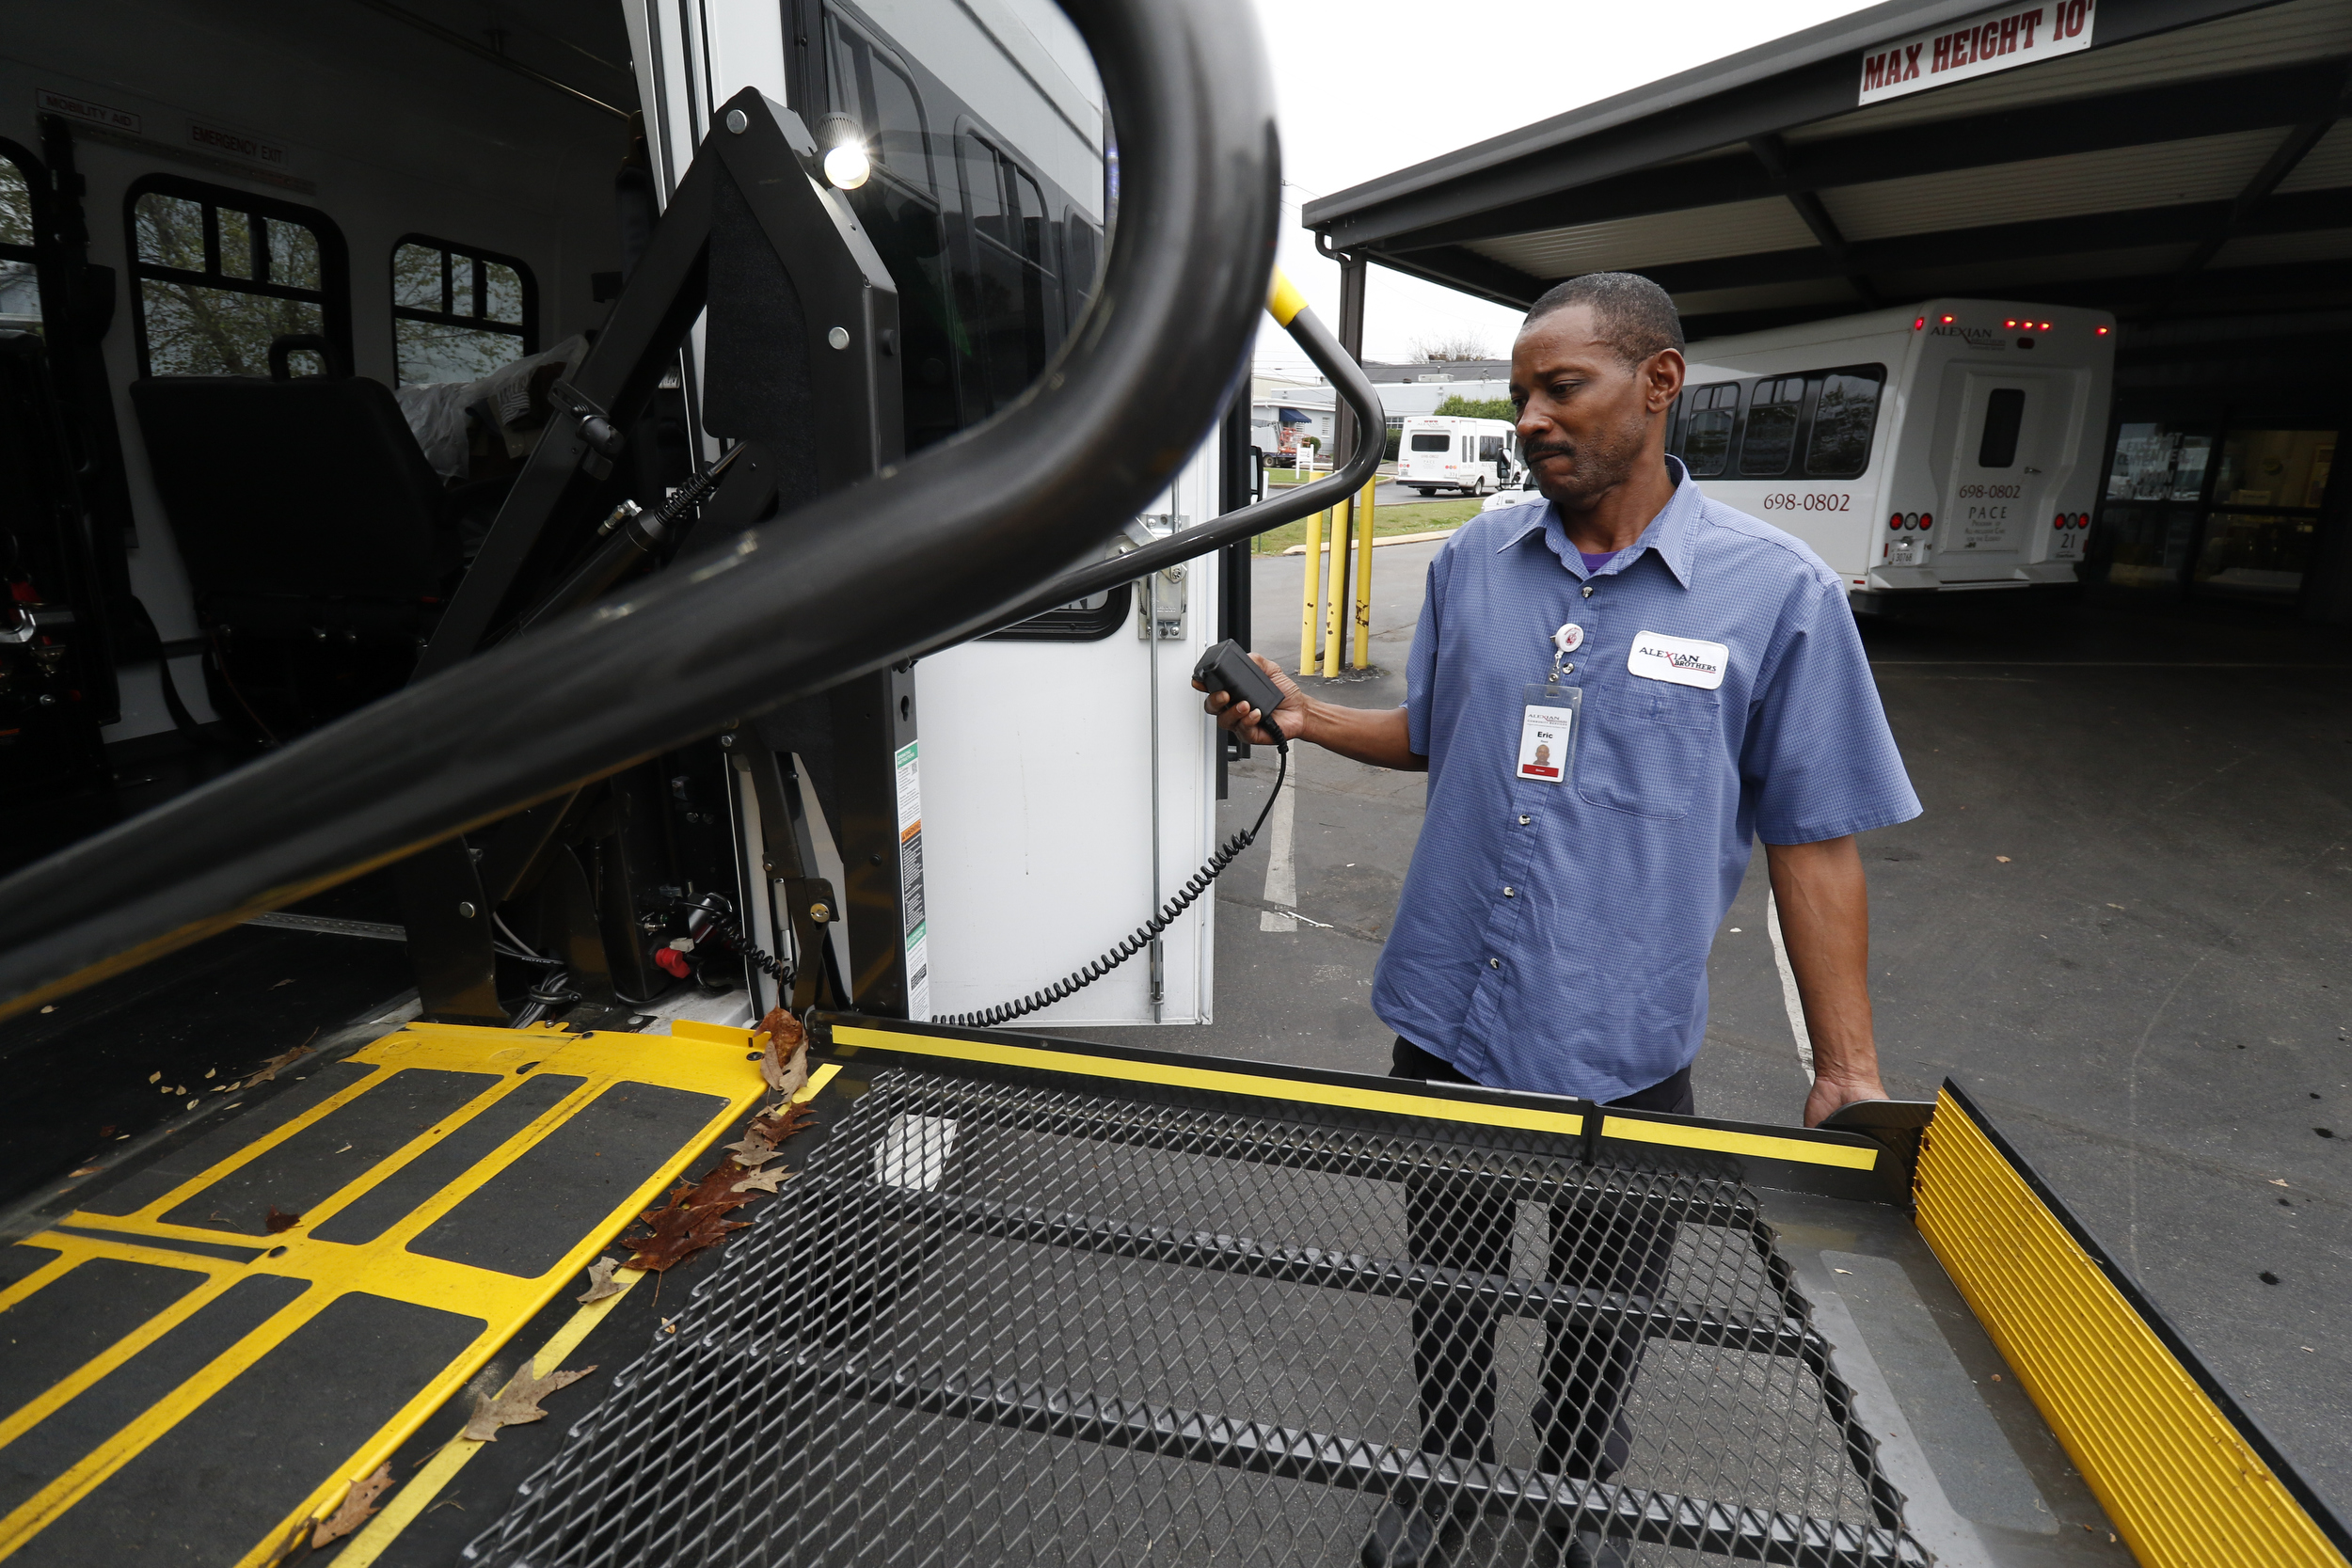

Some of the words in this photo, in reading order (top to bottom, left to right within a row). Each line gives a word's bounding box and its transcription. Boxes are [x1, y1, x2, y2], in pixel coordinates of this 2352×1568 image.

[1863, 42, 1923, 92] MAX
[1931, 8, 2043, 74] HEIGHT
[46, 95, 105, 120] MOBILITY
[112, 113, 133, 126] AID
[192, 126, 257, 155] EMERGENCY
[261, 146, 283, 163] EXIT
[1930, 326, 1993, 339] ALEXIAN
[1959, 484, 2021, 499] 698-0802
[1763, 493, 1851, 512] 698-0802
[2060, 533, 2075, 548] 21
[1639, 646, 1700, 663] ALEXIAN
[1675, 659, 1717, 673] BROTHERS
